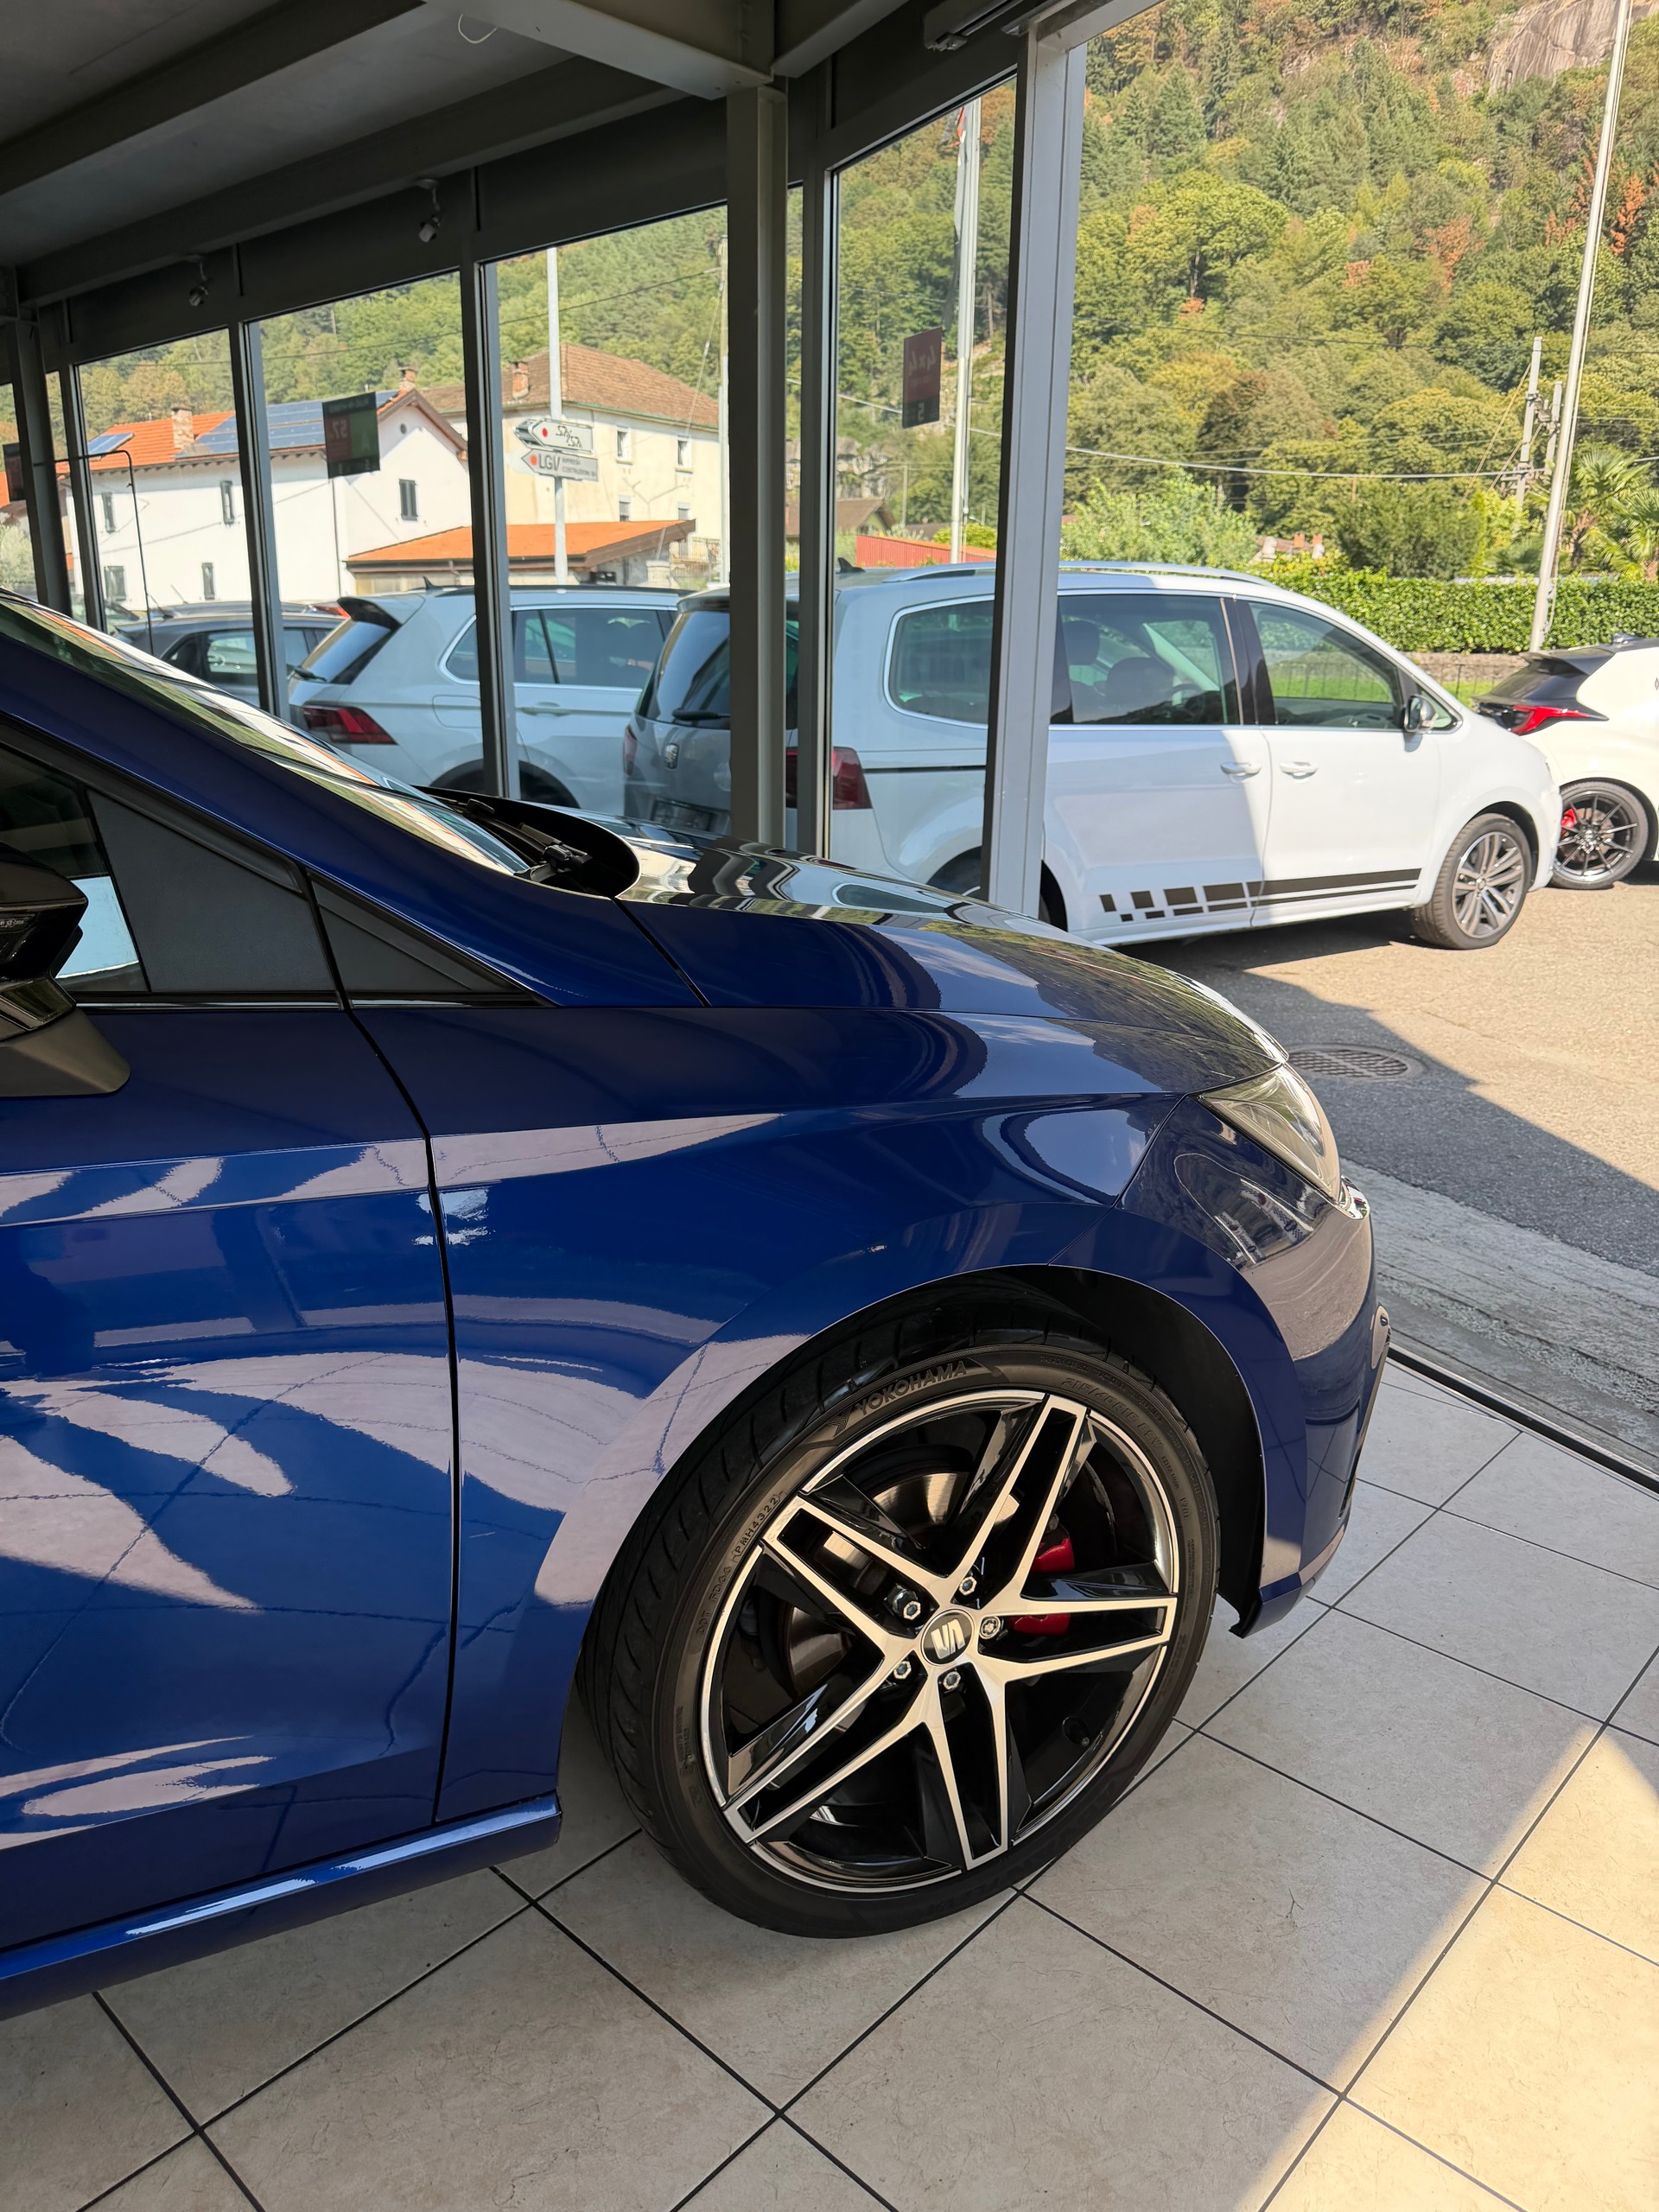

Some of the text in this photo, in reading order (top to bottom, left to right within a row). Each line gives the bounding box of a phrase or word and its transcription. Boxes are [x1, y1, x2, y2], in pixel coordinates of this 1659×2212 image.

[539, 454, 561, 471] LGV
[855, 1360, 968, 1415] YOKOHAMA
[696, 1610, 712, 1636] DOT
[735, 1497, 779, 1554] PMH4322
